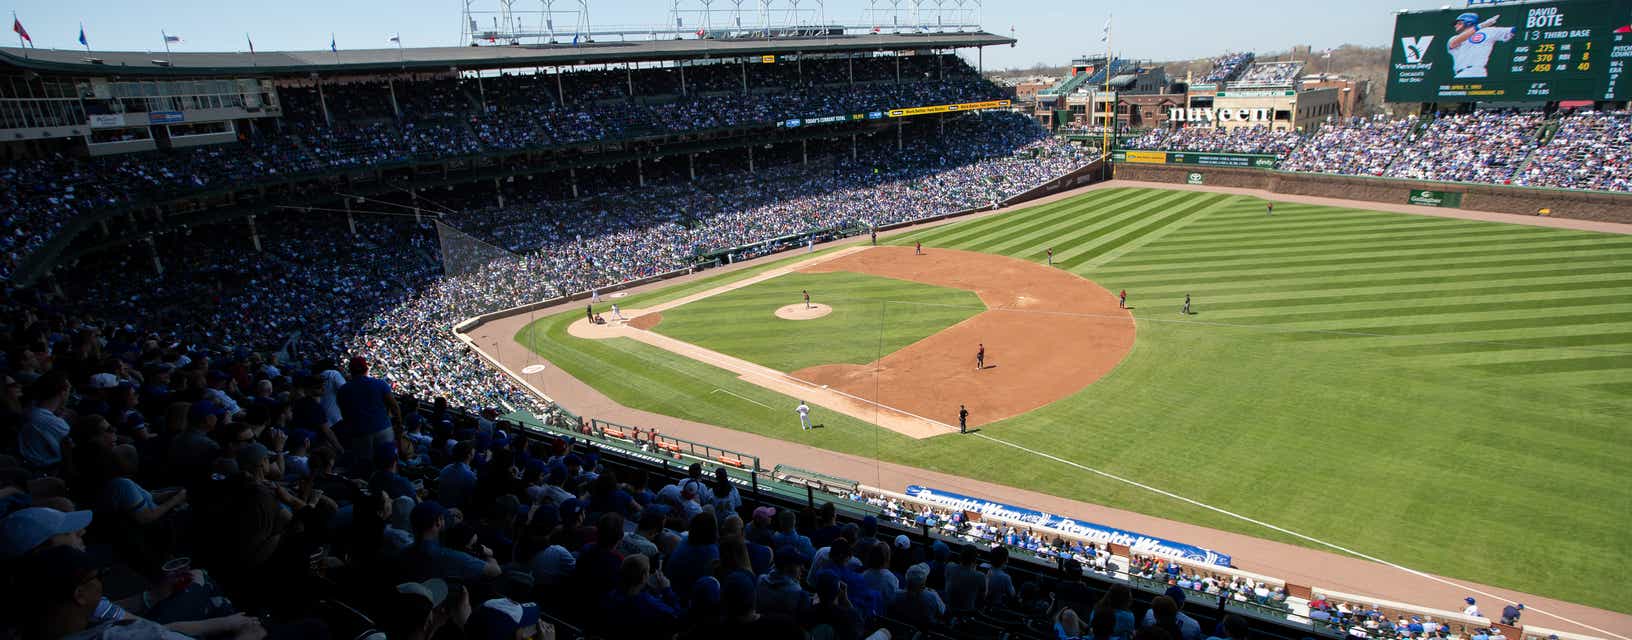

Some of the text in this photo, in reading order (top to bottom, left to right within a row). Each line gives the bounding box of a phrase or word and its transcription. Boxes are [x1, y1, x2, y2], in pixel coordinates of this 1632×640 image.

[1528, 7, 1557, 16] DAVID
[1526, 14, 1564, 28] BOTE
[1544, 31, 1568, 39] THIRD
[1569, 29, 1591, 37] BASE
[1168, 107, 1269, 122] nuveen
